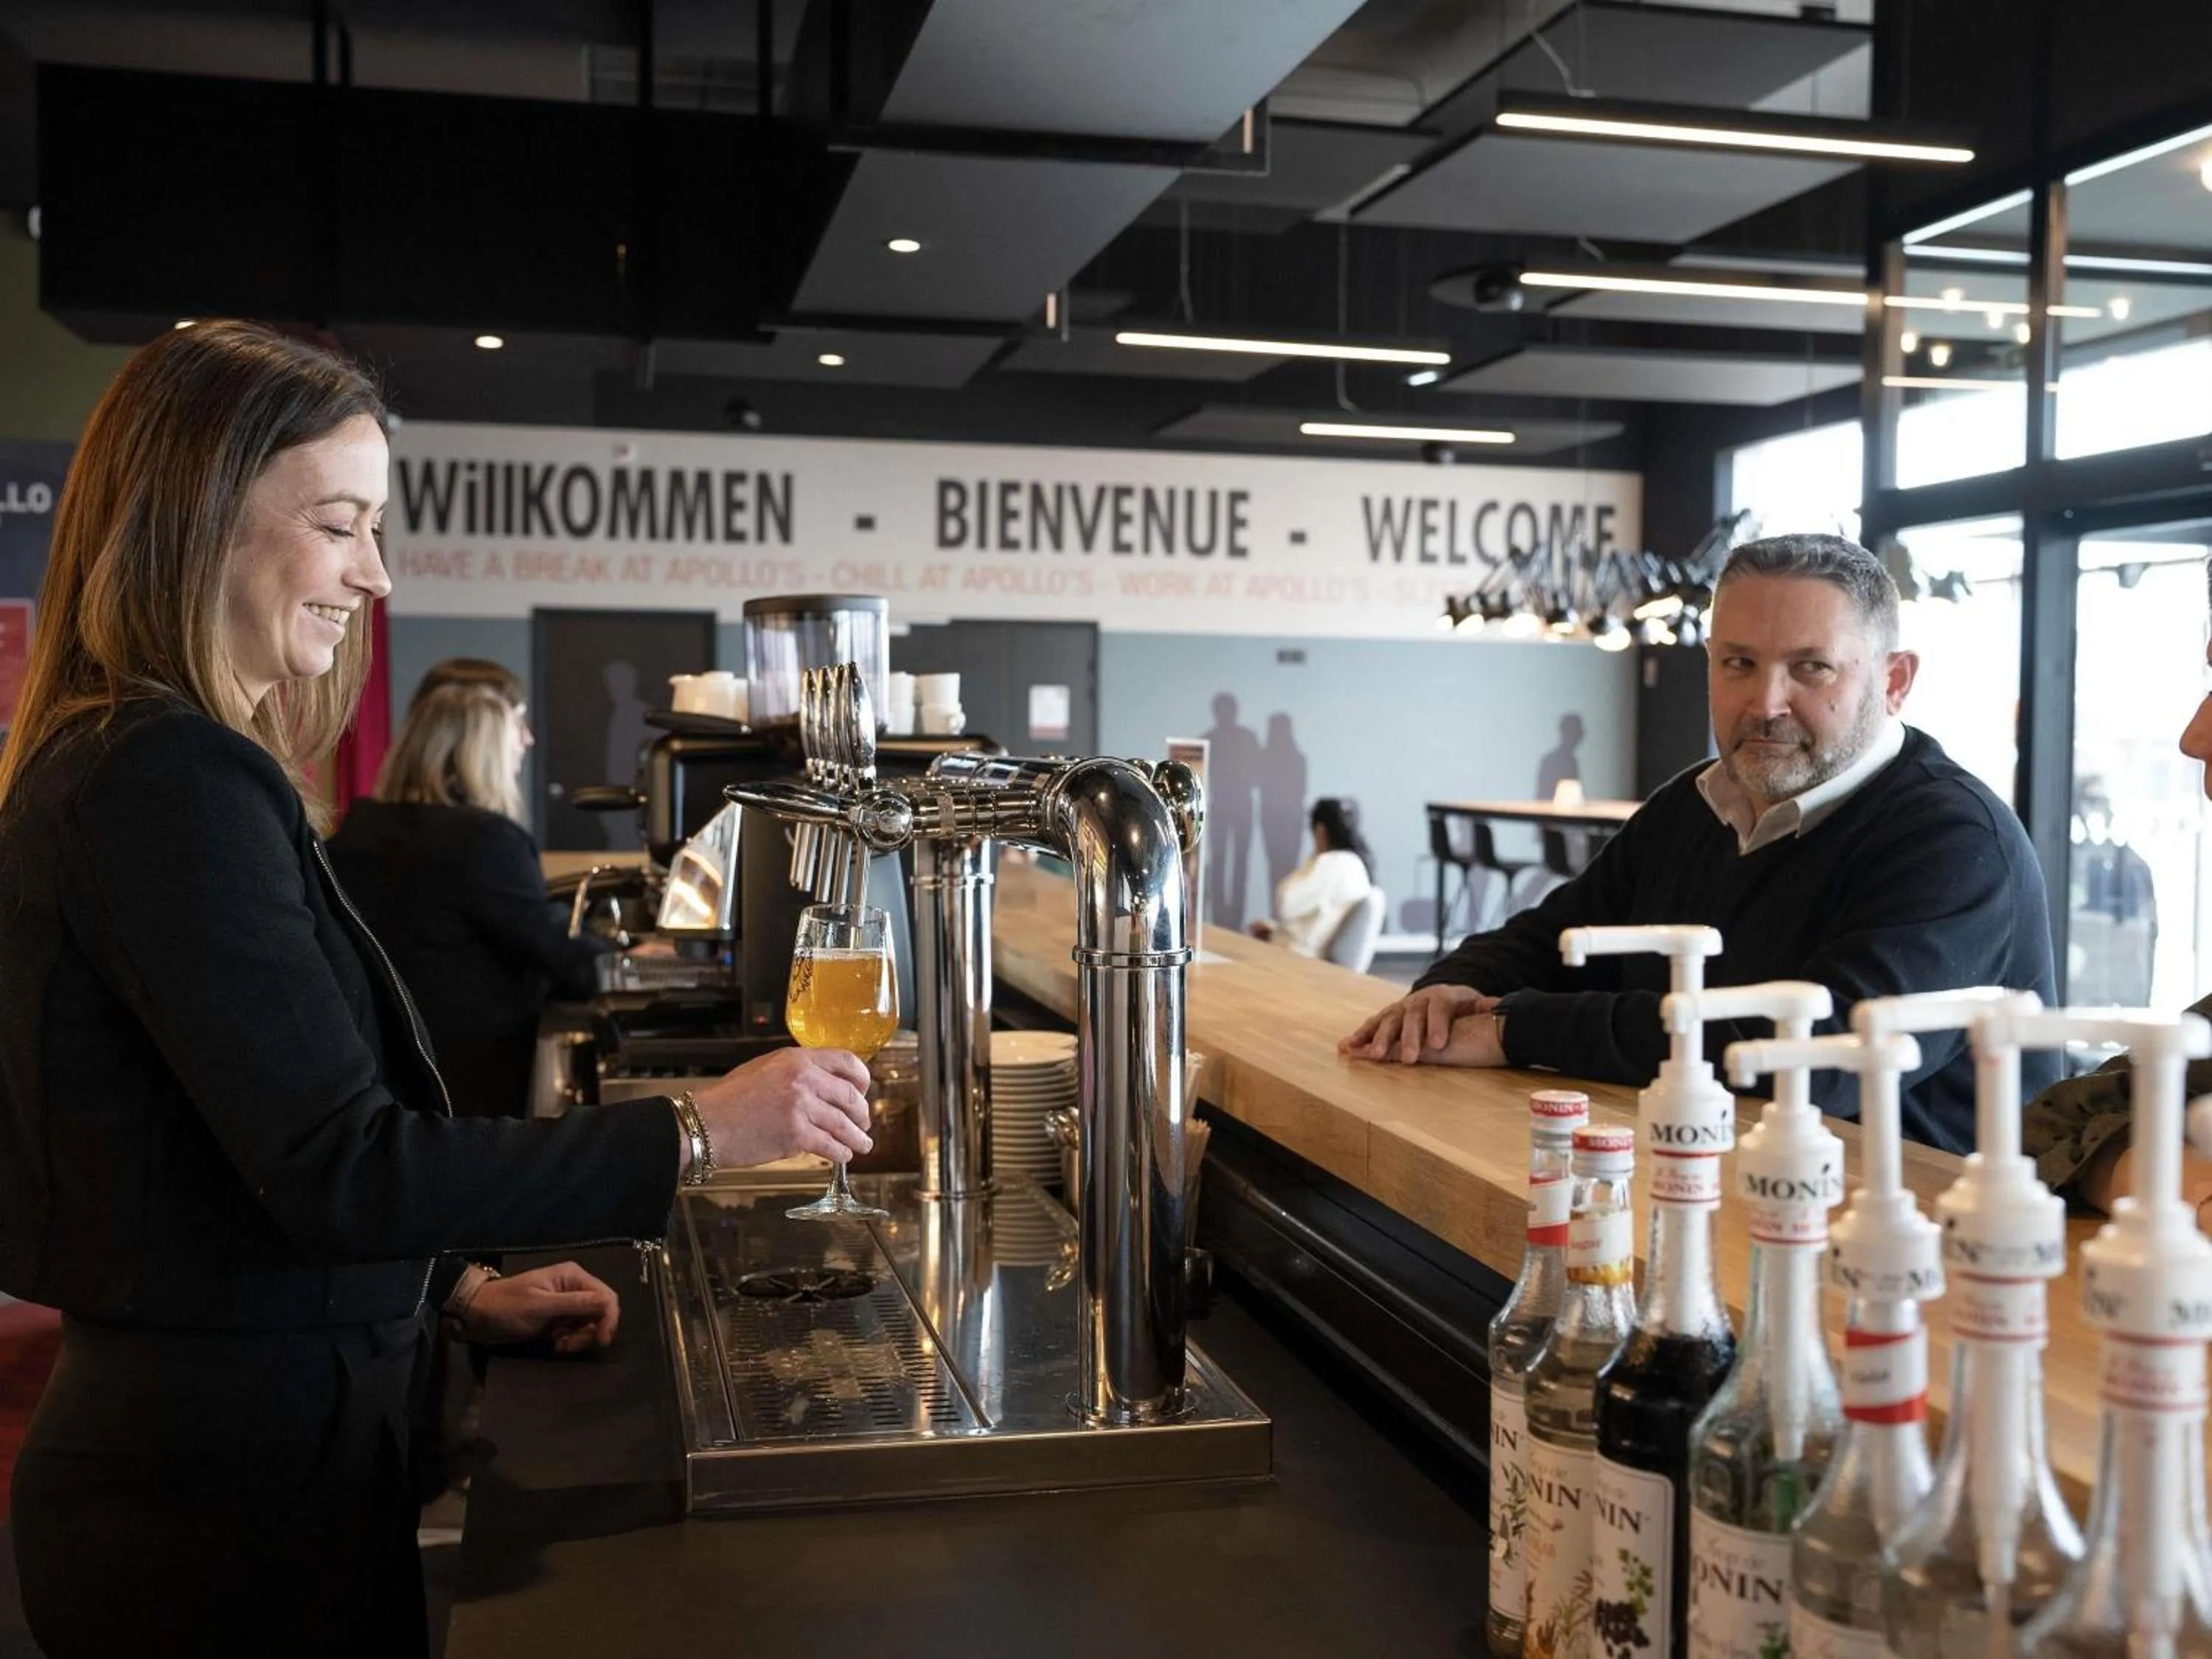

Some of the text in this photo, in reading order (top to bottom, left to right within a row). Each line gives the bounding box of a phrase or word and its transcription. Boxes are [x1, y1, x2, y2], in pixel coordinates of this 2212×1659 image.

[936, 479, 1250, 558] BIENVENUE
[1361, 495, 1617, 568] WELCOME
[398, 548, 473, 580] HAVE
[482, 552, 507, 580] A
[512, 551, 615, 583] BREAK
[621, 555, 653, 583] AT
[665, 557, 804, 588] APOLLO'S
[830, 561, 908, 591] CHILL
[918, 564, 952, 588] AT
[961, 566, 1096, 595] APOLLO'S
[1119, 571, 1196, 599] WORK
[1205, 573, 1234, 598] AT
[1246, 574, 1370, 603] APOLLO'S
